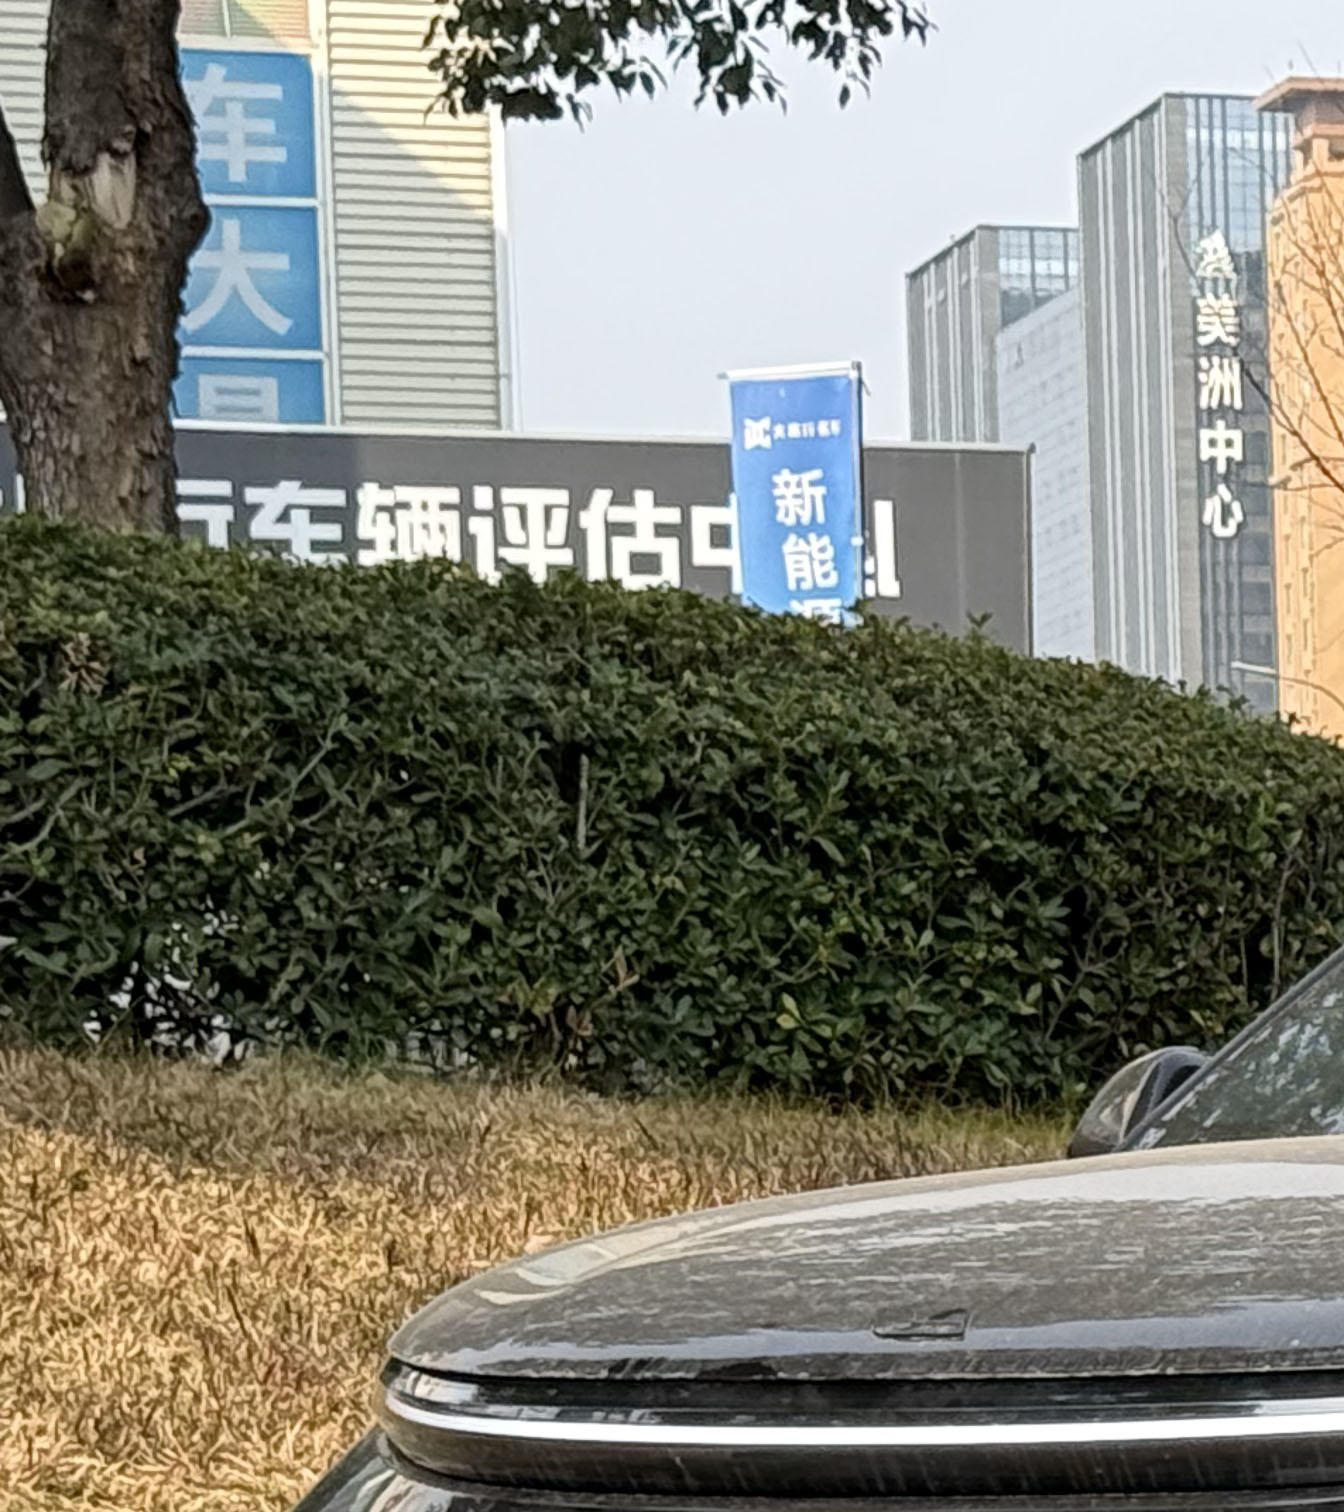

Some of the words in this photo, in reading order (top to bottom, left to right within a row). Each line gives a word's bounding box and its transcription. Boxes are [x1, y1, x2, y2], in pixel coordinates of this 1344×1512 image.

[176, 480, 900, 598] 车辆评估中
